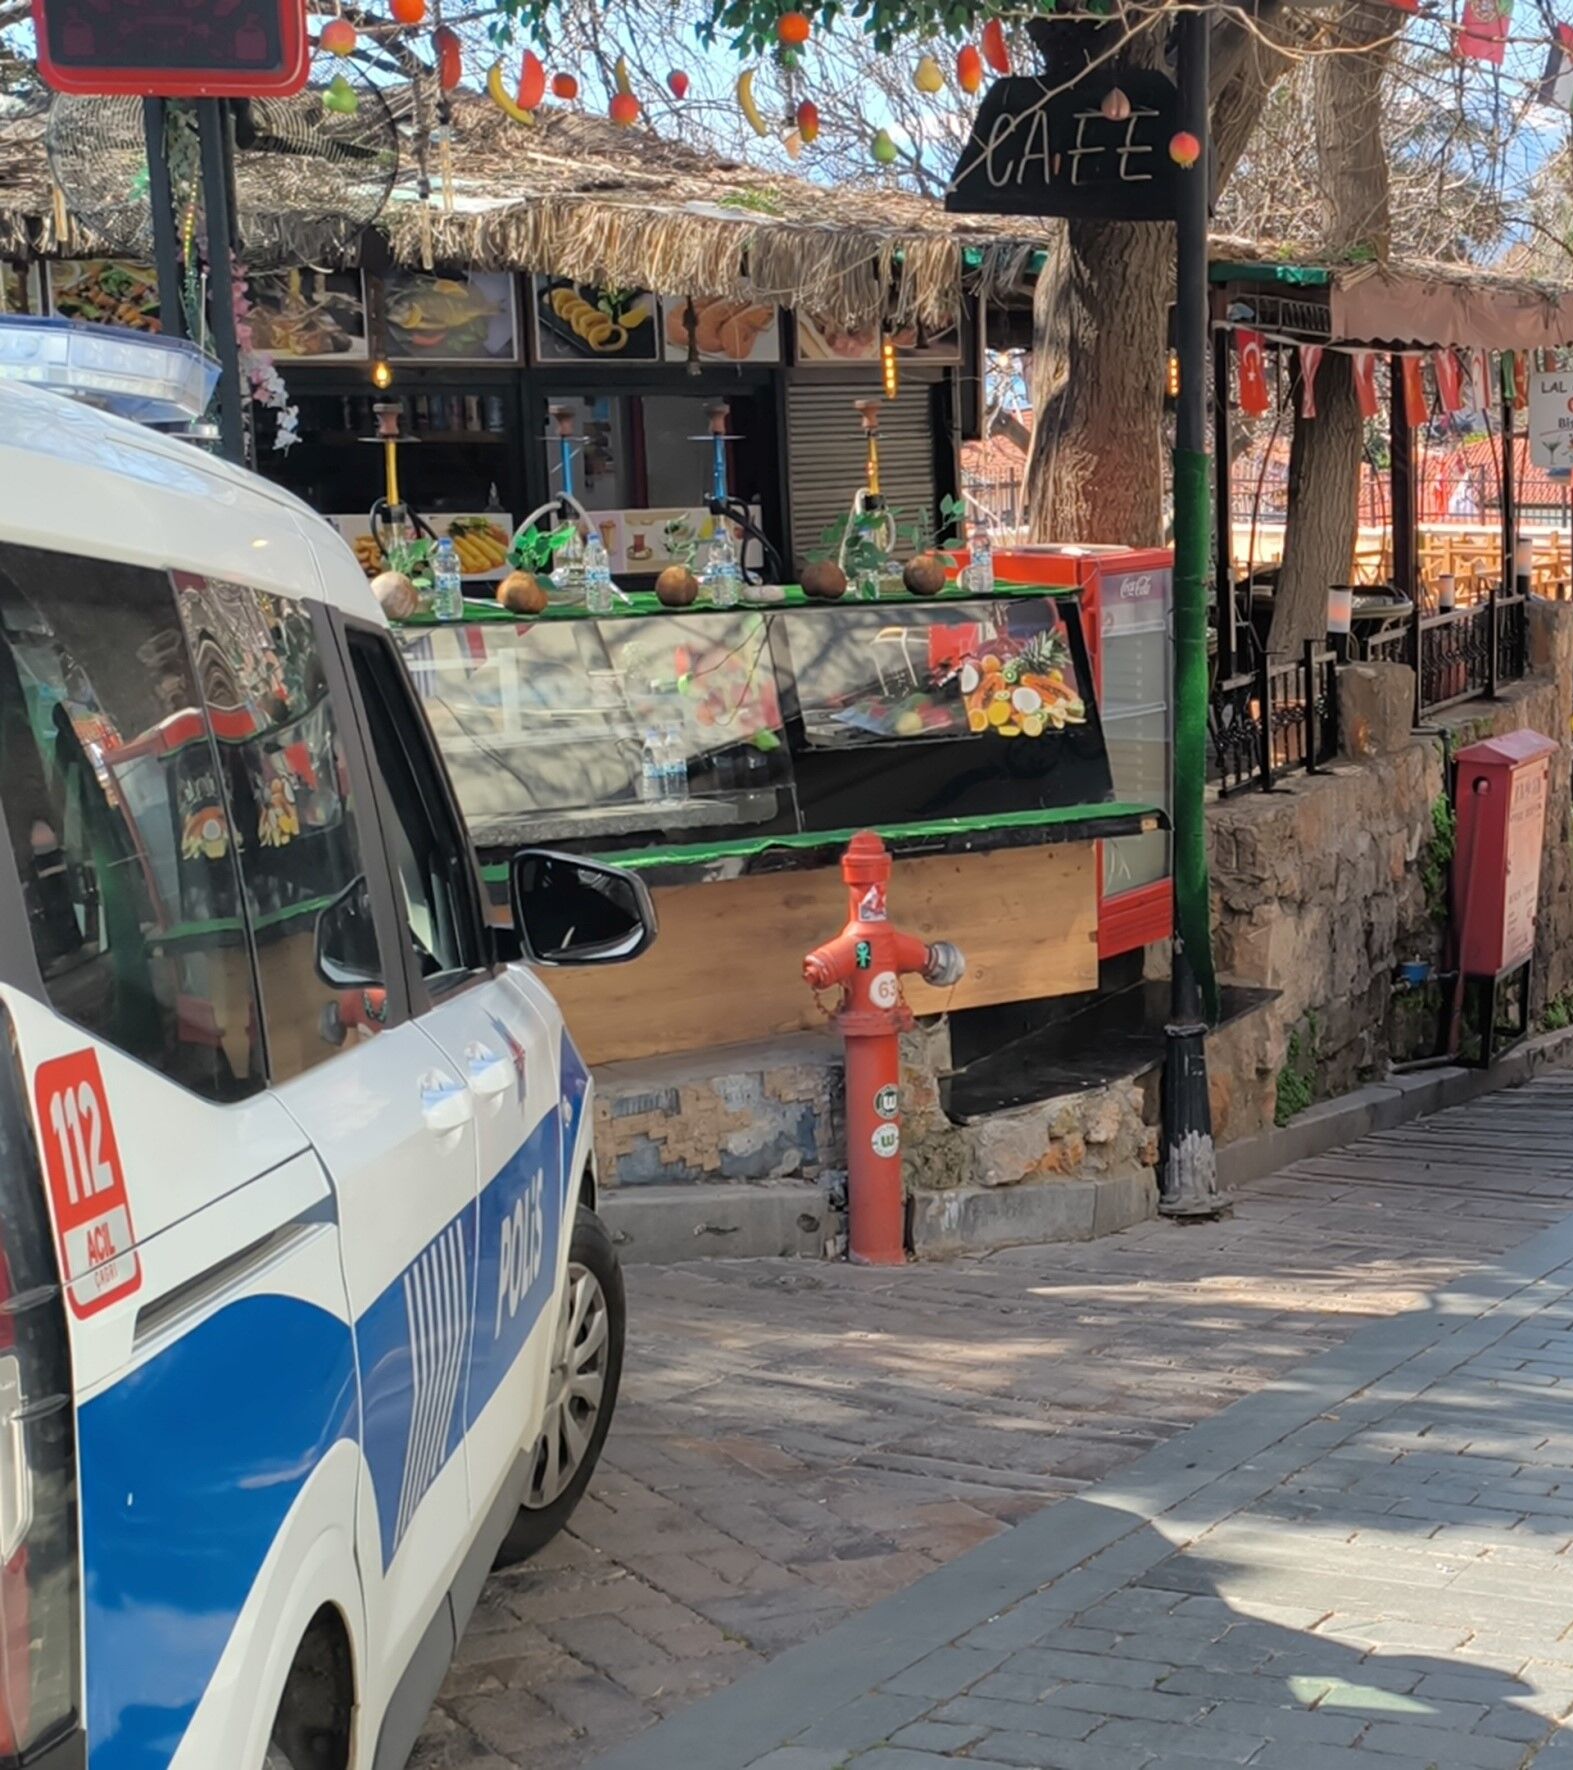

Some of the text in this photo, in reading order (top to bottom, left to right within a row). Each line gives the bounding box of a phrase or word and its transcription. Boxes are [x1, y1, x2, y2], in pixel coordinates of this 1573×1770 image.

[986, 109, 1160, 187] CAFE
[1541, 381, 1567, 394] LAL
[50, 1080, 115, 1205] 112
